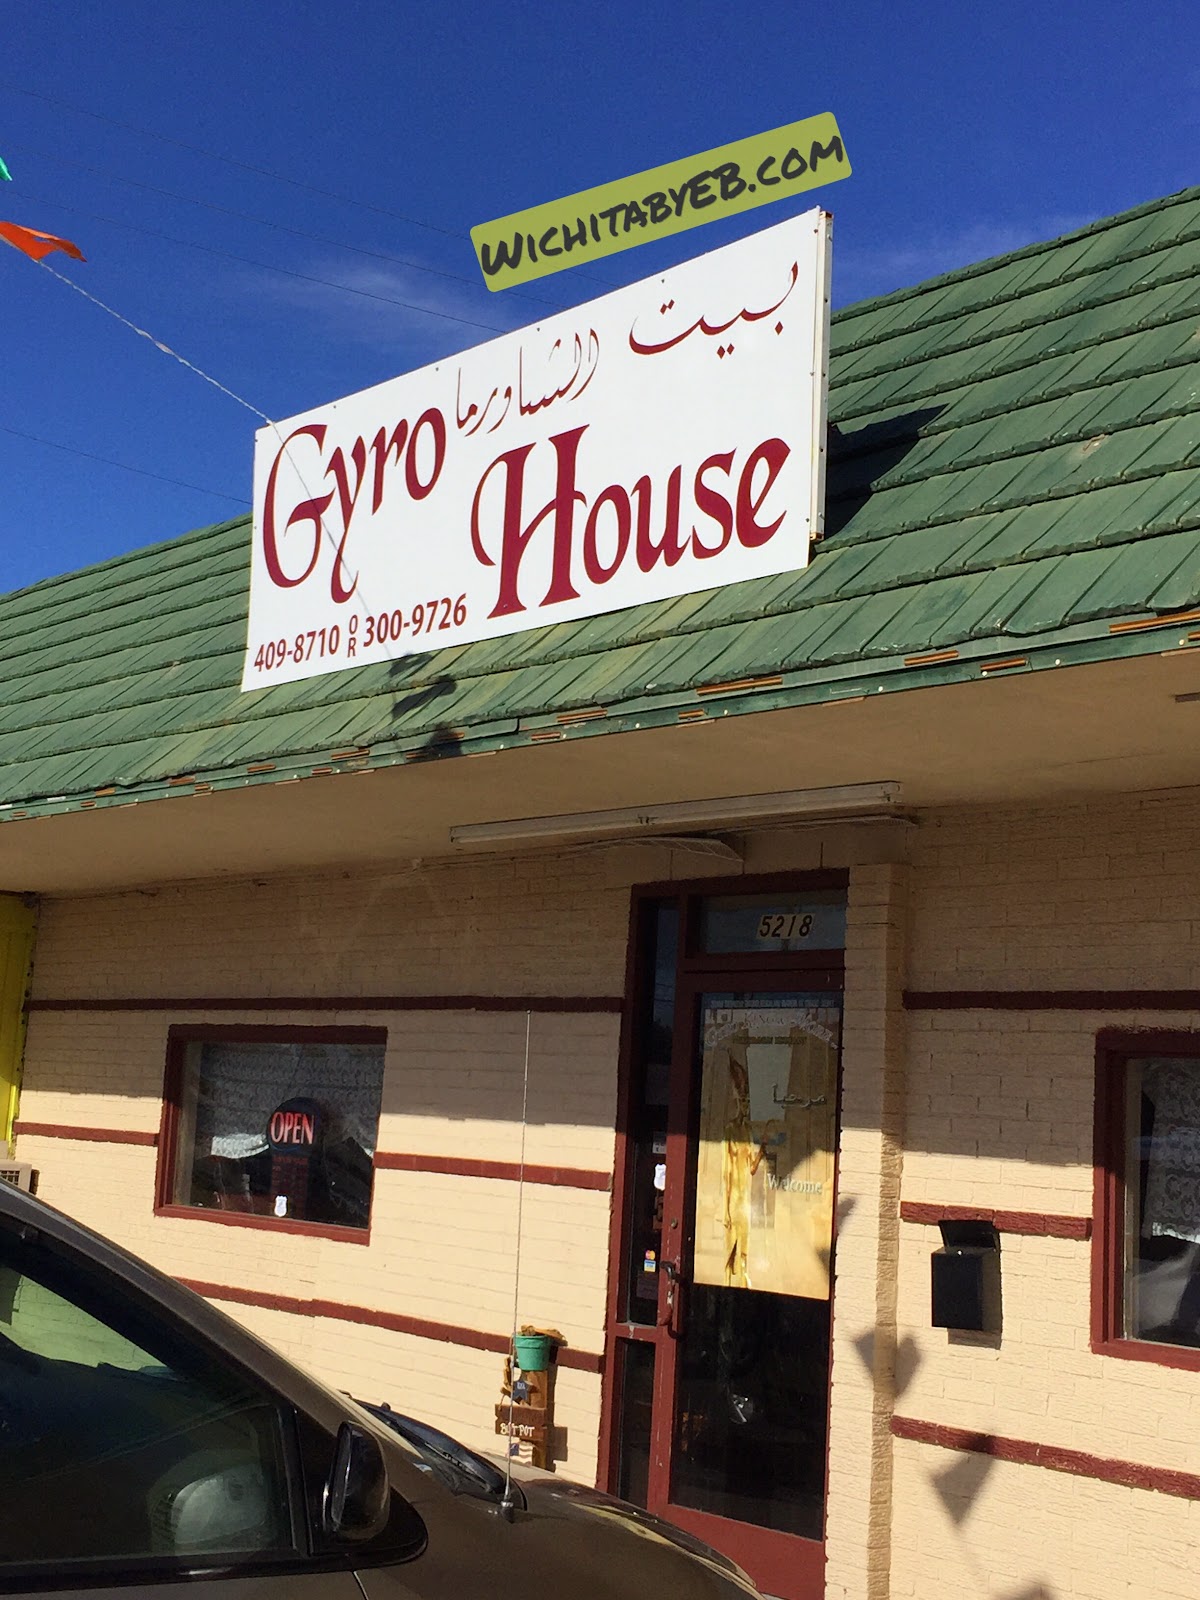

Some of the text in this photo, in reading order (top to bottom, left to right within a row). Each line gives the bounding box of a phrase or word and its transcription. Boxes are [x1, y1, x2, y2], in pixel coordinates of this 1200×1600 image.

[628, 260, 799, 363] بيت
[262, 408, 447, 604] Gyro
[470, 424, 791, 619] House
[253, 623, 340, 674] 409-8710
[363, 592, 468, 649] 300-9726
[758, 914, 813, 938] 5218
[269, 1111, 315, 1145] OPEN
[766, 1173, 823, 1195] Welcome
